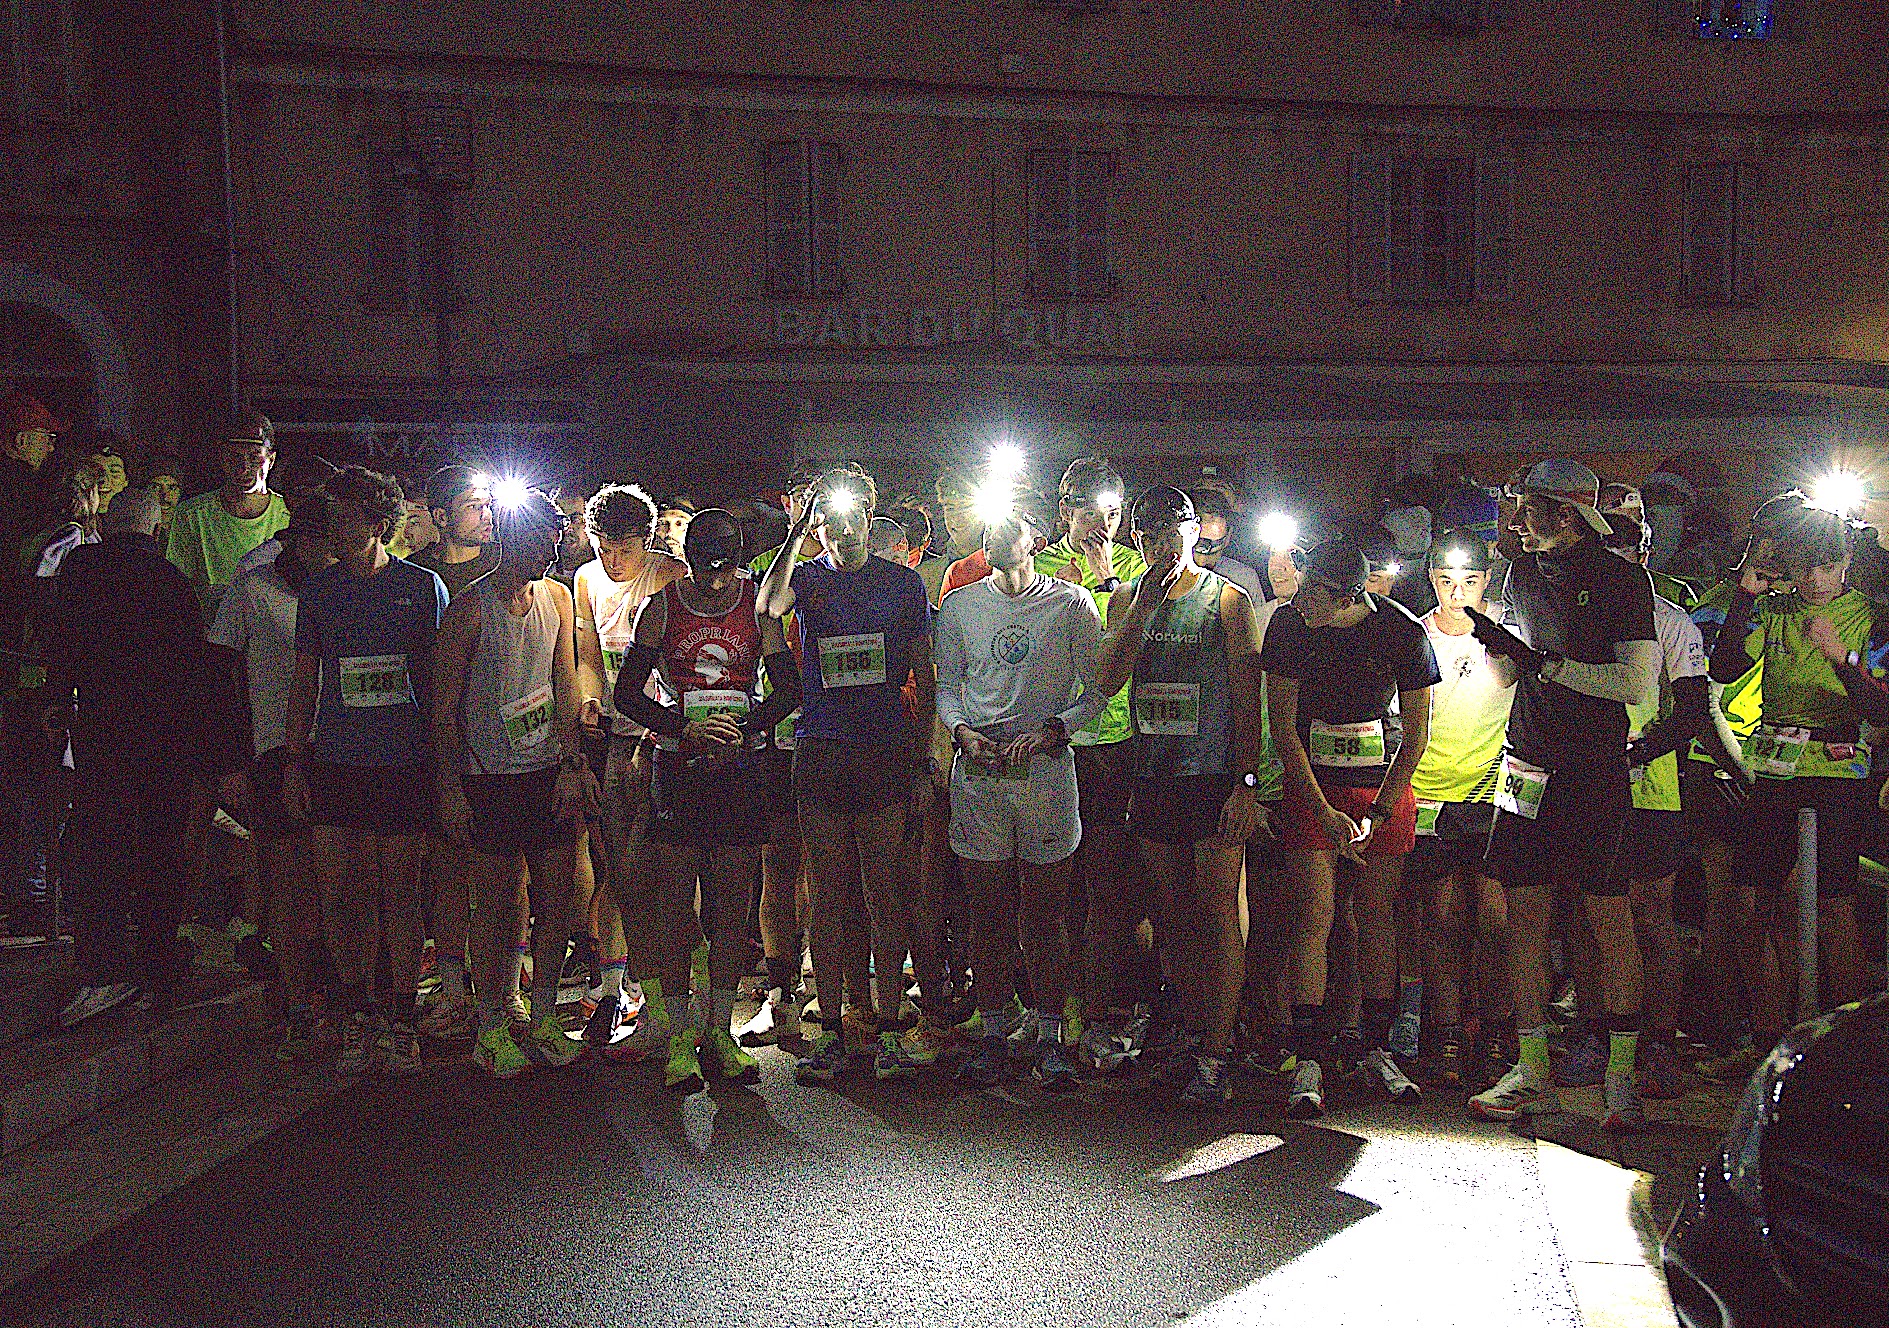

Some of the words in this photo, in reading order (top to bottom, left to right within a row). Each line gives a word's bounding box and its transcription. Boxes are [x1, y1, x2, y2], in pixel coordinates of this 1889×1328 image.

[773, 307, 889, 347] BAR
[834, 650, 872, 671] 156
[521, 704, 549, 732] 132
[1144, 700, 1182, 719] 115
[1333, 737, 1362, 756] 58
